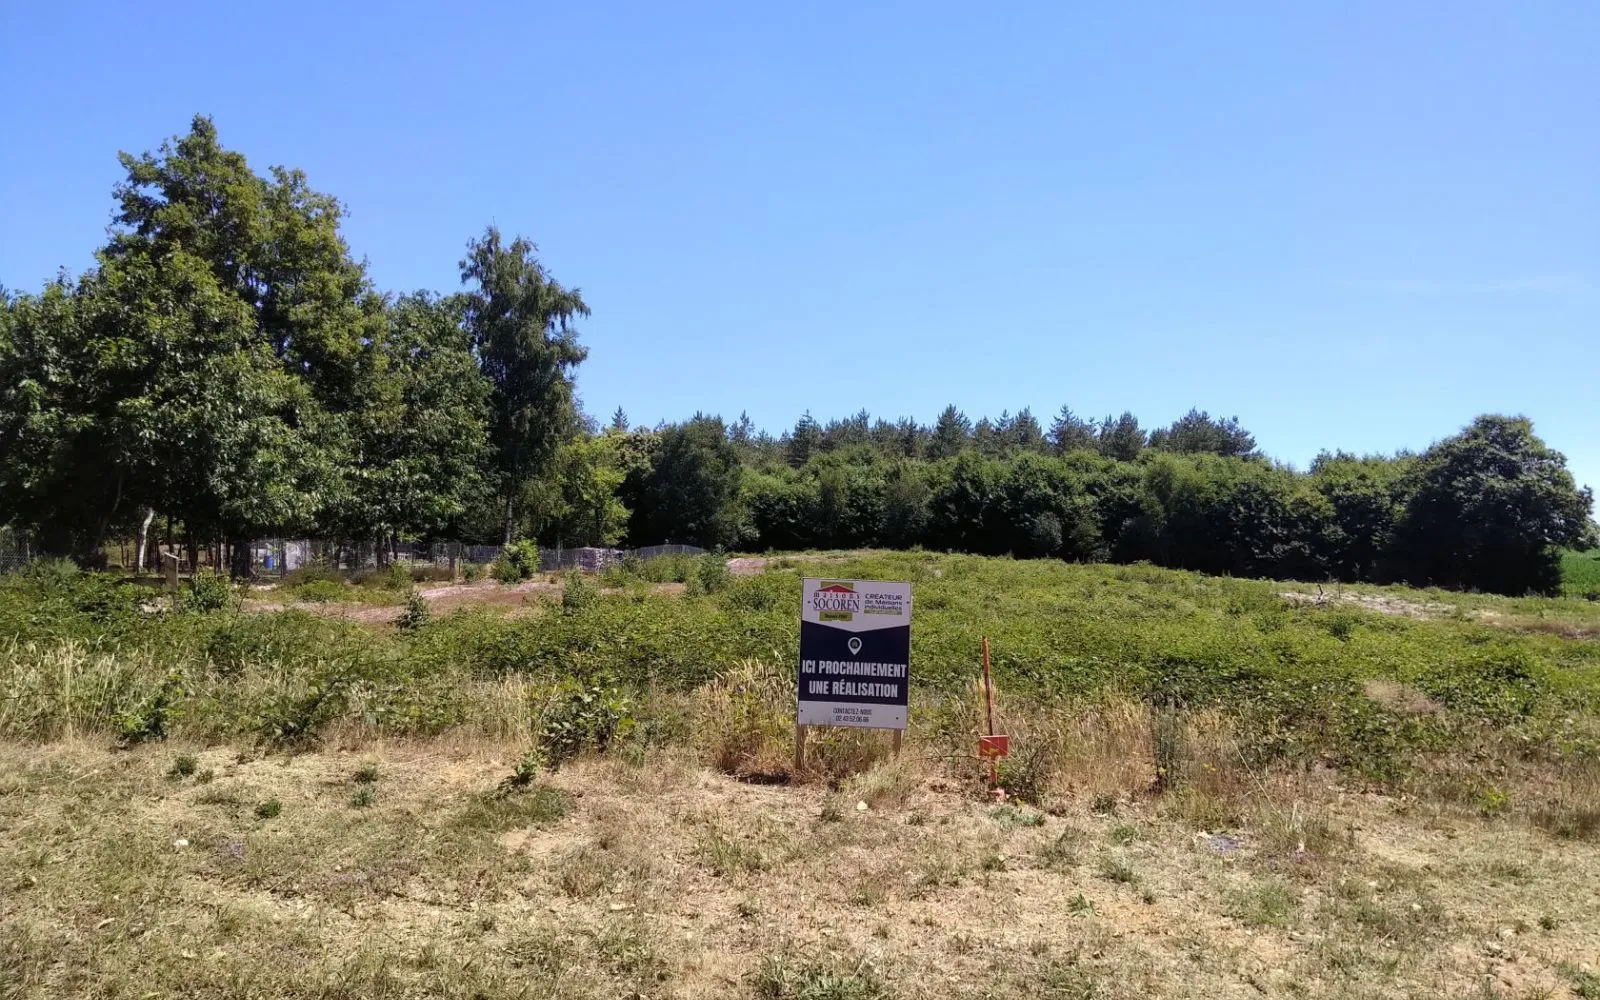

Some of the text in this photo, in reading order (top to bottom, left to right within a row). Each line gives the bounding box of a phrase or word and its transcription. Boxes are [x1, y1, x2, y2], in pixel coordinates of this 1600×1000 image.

[813, 598, 860, 611] SOCOREN
[802, 660, 907, 678] ICI PROCHAINEMENT
[809, 679, 898, 698] UNE RÉALISATION
